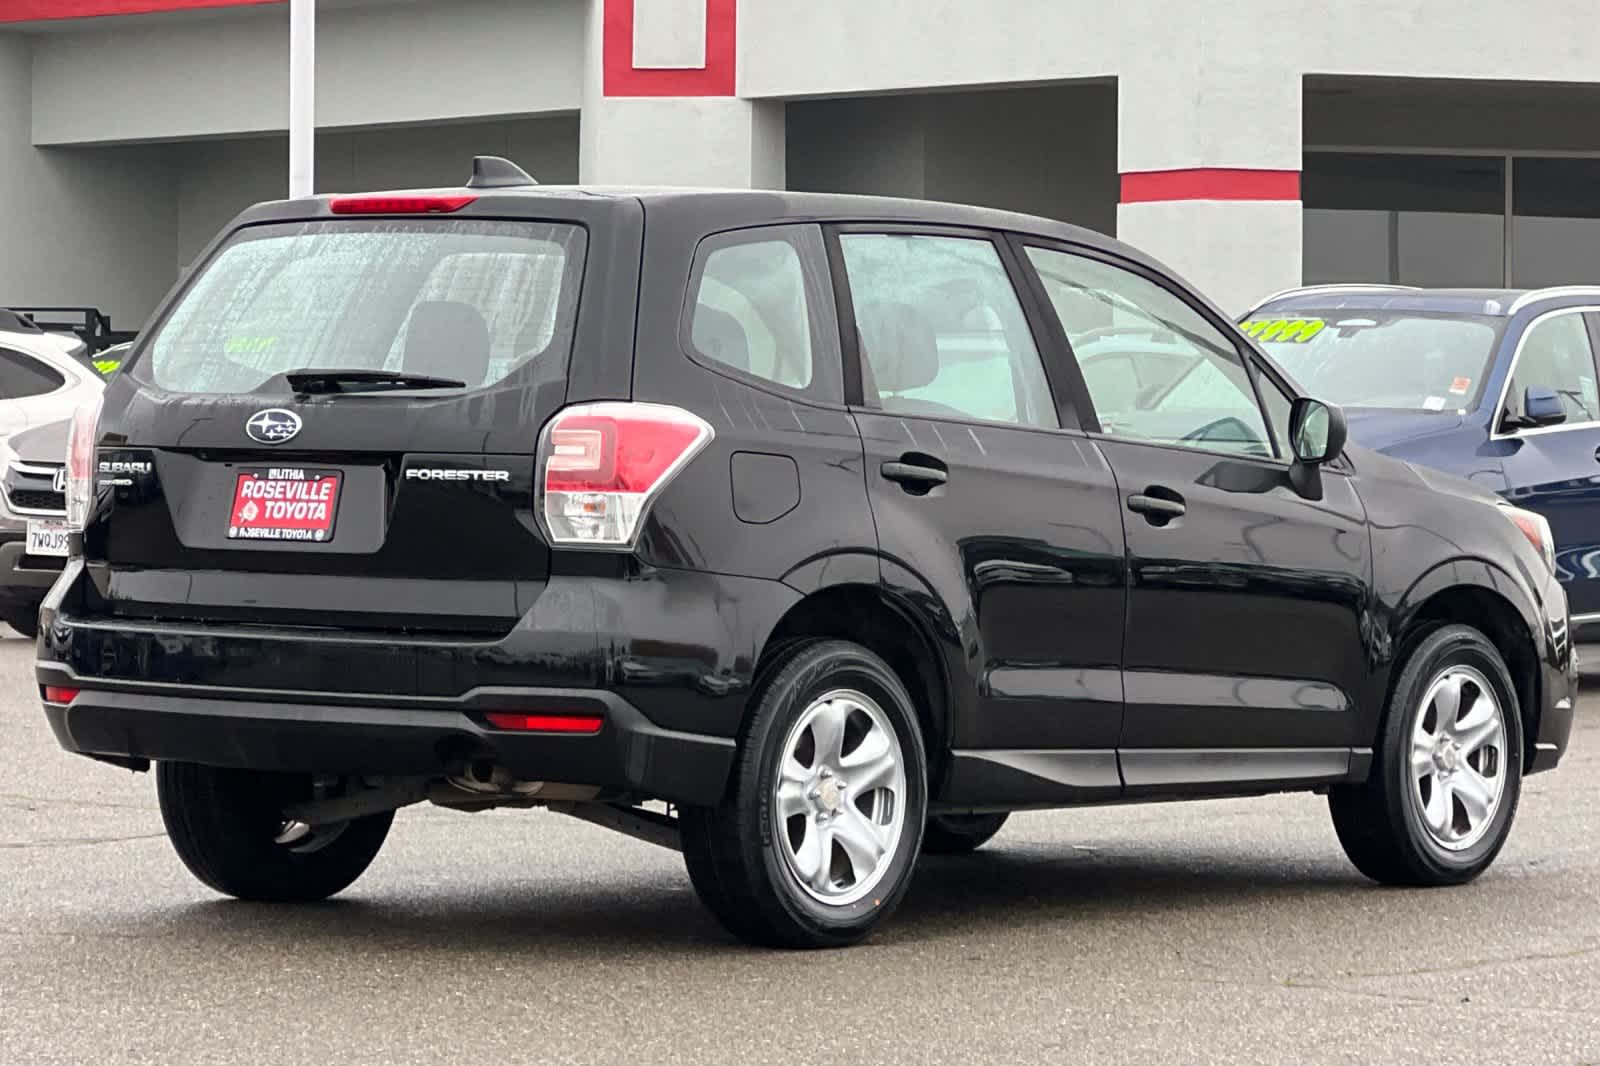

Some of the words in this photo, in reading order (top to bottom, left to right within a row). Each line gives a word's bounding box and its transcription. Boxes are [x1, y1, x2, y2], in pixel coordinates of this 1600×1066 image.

[99, 462, 152, 473] SUBARU
[279, 469, 305, 480] LITHIA
[405, 469, 510, 481] FORESTER
[241, 481, 332, 500] ROSEVILLE
[264, 500, 327, 520] TOYOTA
[281, 528, 313, 540] TOYOTA
